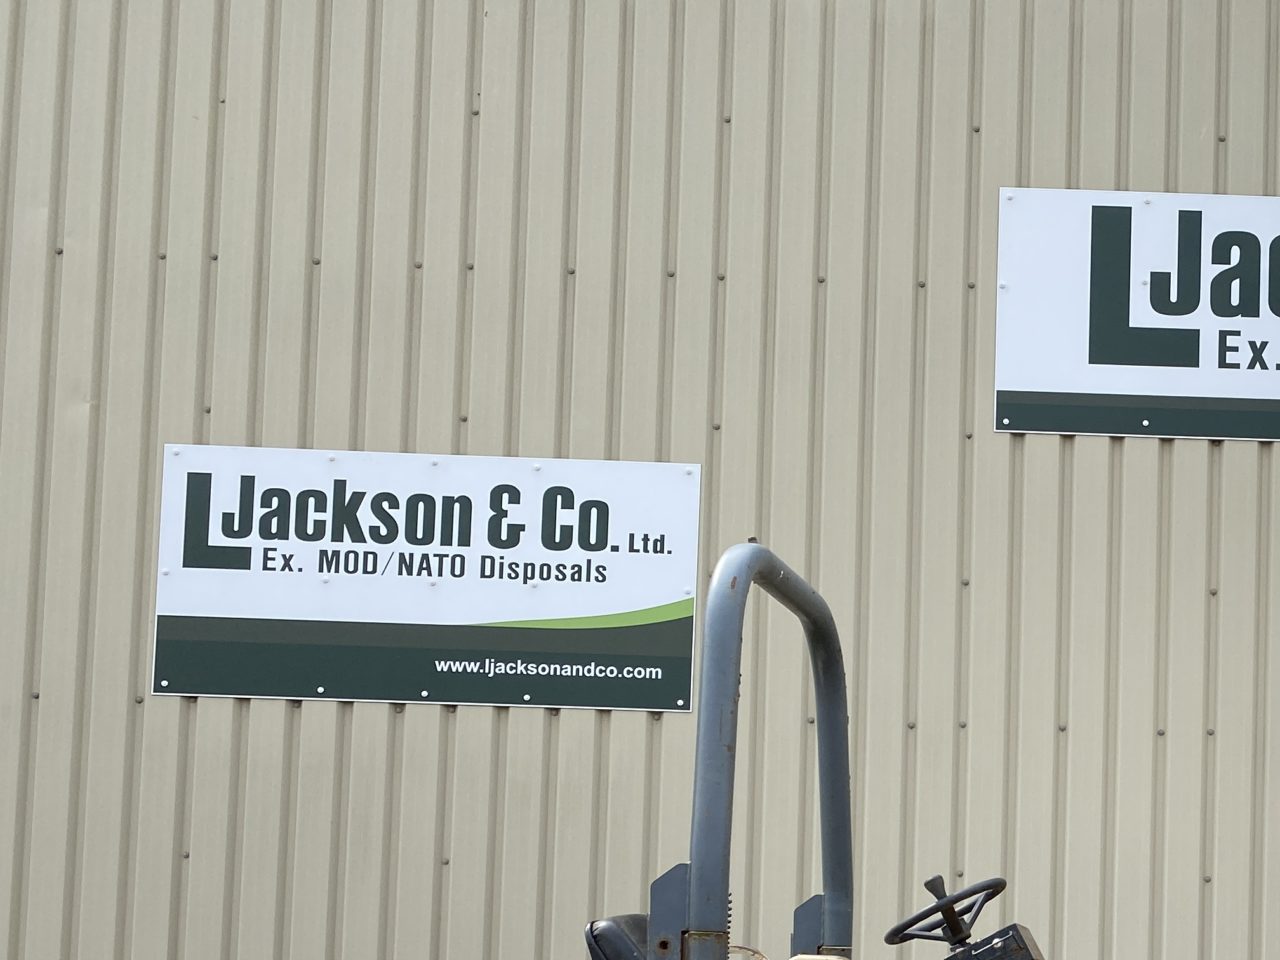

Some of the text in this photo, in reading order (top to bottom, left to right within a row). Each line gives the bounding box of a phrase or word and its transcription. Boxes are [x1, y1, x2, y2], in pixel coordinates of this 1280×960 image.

[487, 484, 526, 550] &
[540, 485, 620, 553] Co.
[628, 533, 672, 555] Ltd.
[262, 547, 608, 585] Ex. MOD/NATO Disposals
[434, 658, 663, 680] www.ljacksonandco.com
